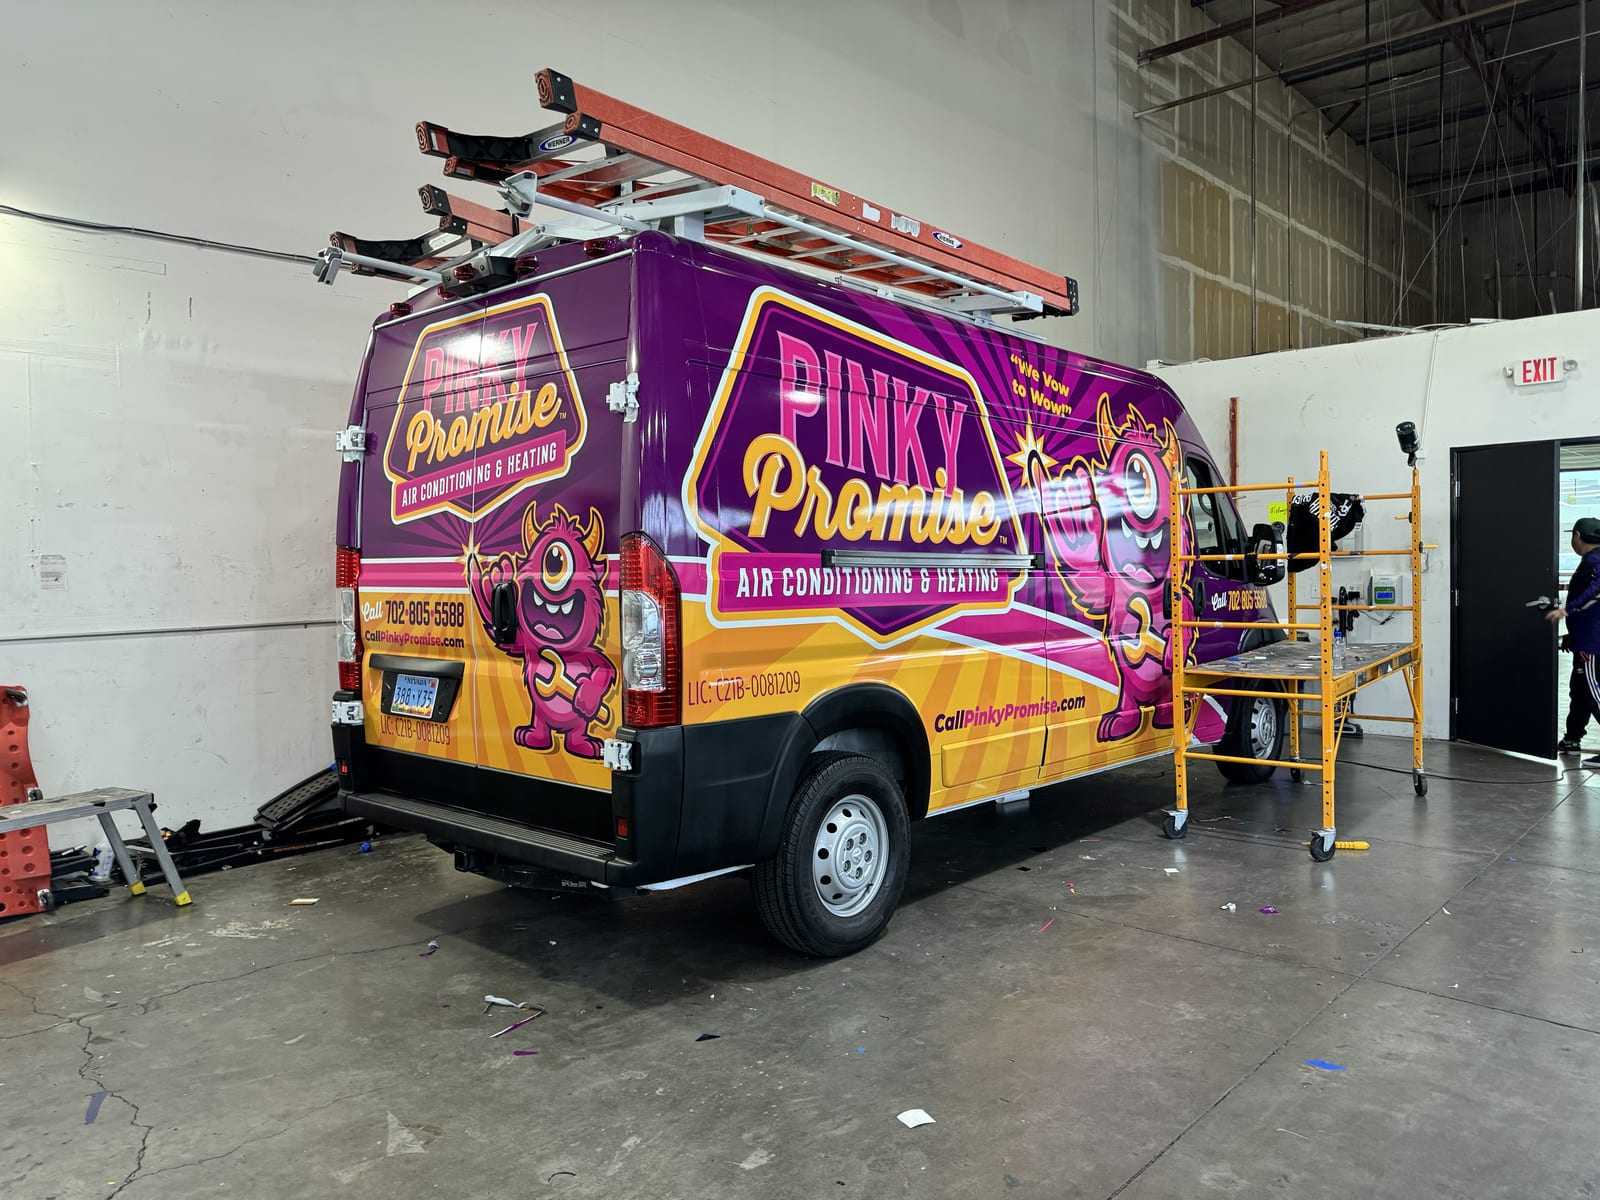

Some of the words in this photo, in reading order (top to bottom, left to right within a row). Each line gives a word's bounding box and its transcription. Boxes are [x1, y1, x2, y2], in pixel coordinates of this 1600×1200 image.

[547, 136, 570, 148] WERNER
[422, 321, 539, 415] PINKY
[1522, 357, 1557, 383] EXIT
[1012, 378, 1027, 398] to
[1042, 371, 1070, 397] Vow
[406, 382, 562, 473] Promise
[777, 330, 968, 497] PINKY
[401, 489, 418, 507] AIR
[420, 463, 491, 501] CONDITIONING
[495, 459, 503, 478] &
[507, 442, 557, 474] HEATING
[743, 433, 1001, 545] Promise
[736, 567, 774, 597] AIR
[782, 567, 913, 596] CONDITIONING
[920, 568, 931, 593] &
[937, 568, 999, 593] HEATING
[361, 601, 383, 622] Call
[1211, 592, 1228, 611] Call
[365, 630, 465, 648] CallPinkyPromise.com
[687, 680, 712, 706] LIC:
[716, 670, 801, 702] C21B-0081209
[934, 695, 1086, 733] CallPinkyPromise.com
[380, 714, 395, 735] LIC:
[395, 717, 451, 745] C21B-0081209
